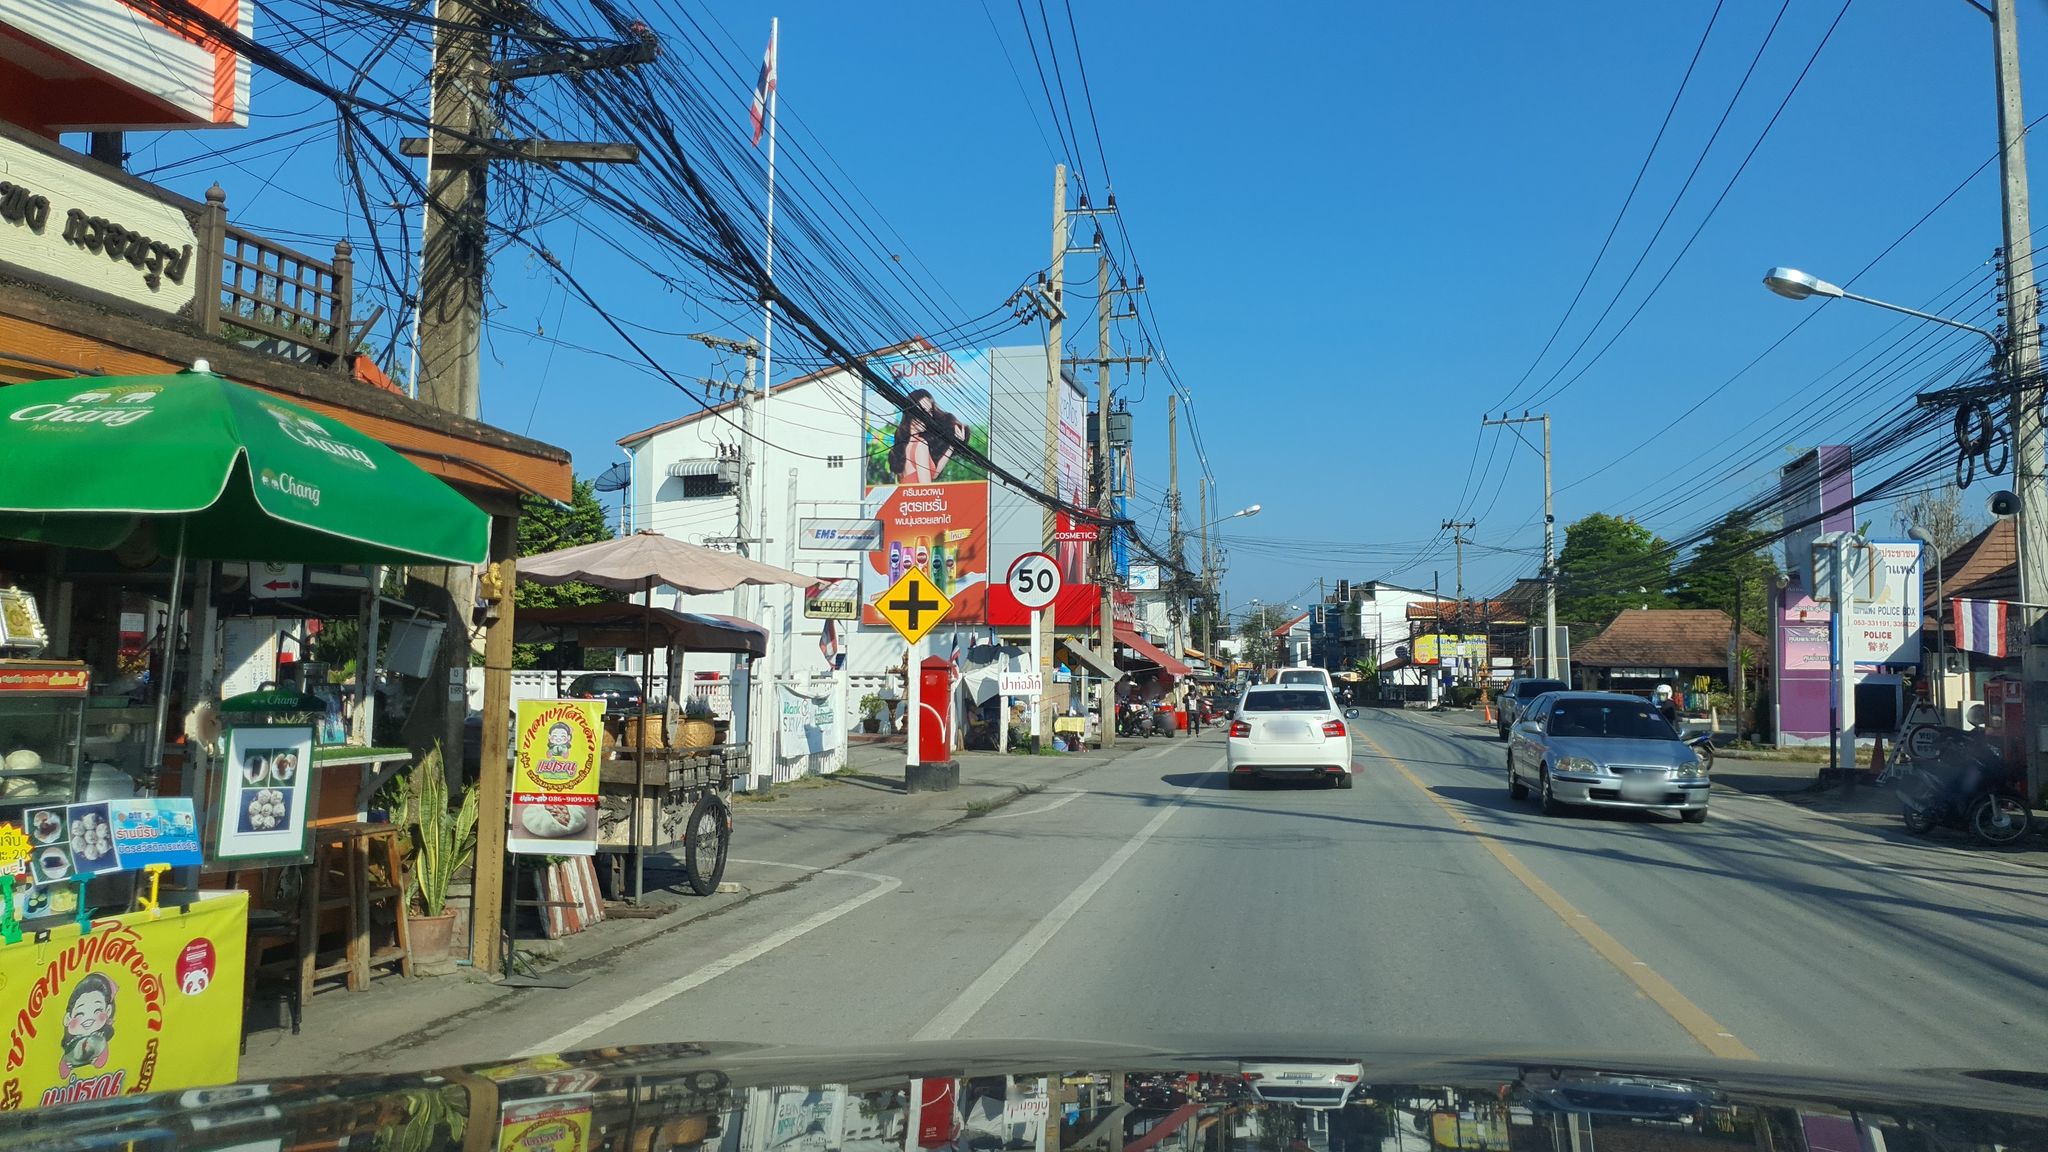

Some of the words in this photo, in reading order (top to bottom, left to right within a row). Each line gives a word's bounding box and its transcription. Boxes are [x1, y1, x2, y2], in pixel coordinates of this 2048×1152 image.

[891, 353, 958, 380] sunsilk
[9, 403, 154, 427] Chang
[278, 421, 377, 470] Chang
[279, 473, 321, 507] Chang
[814, 529, 838, 540] EMS
[1055, 531, 1099, 541] COSMETICS
[1018, 568, 1054, 593] 50
[1877, 606, 1900, 616] POLICE
[1902, 606, 1916, 616] BOX
[1863, 631, 1892, 640] POLICE
